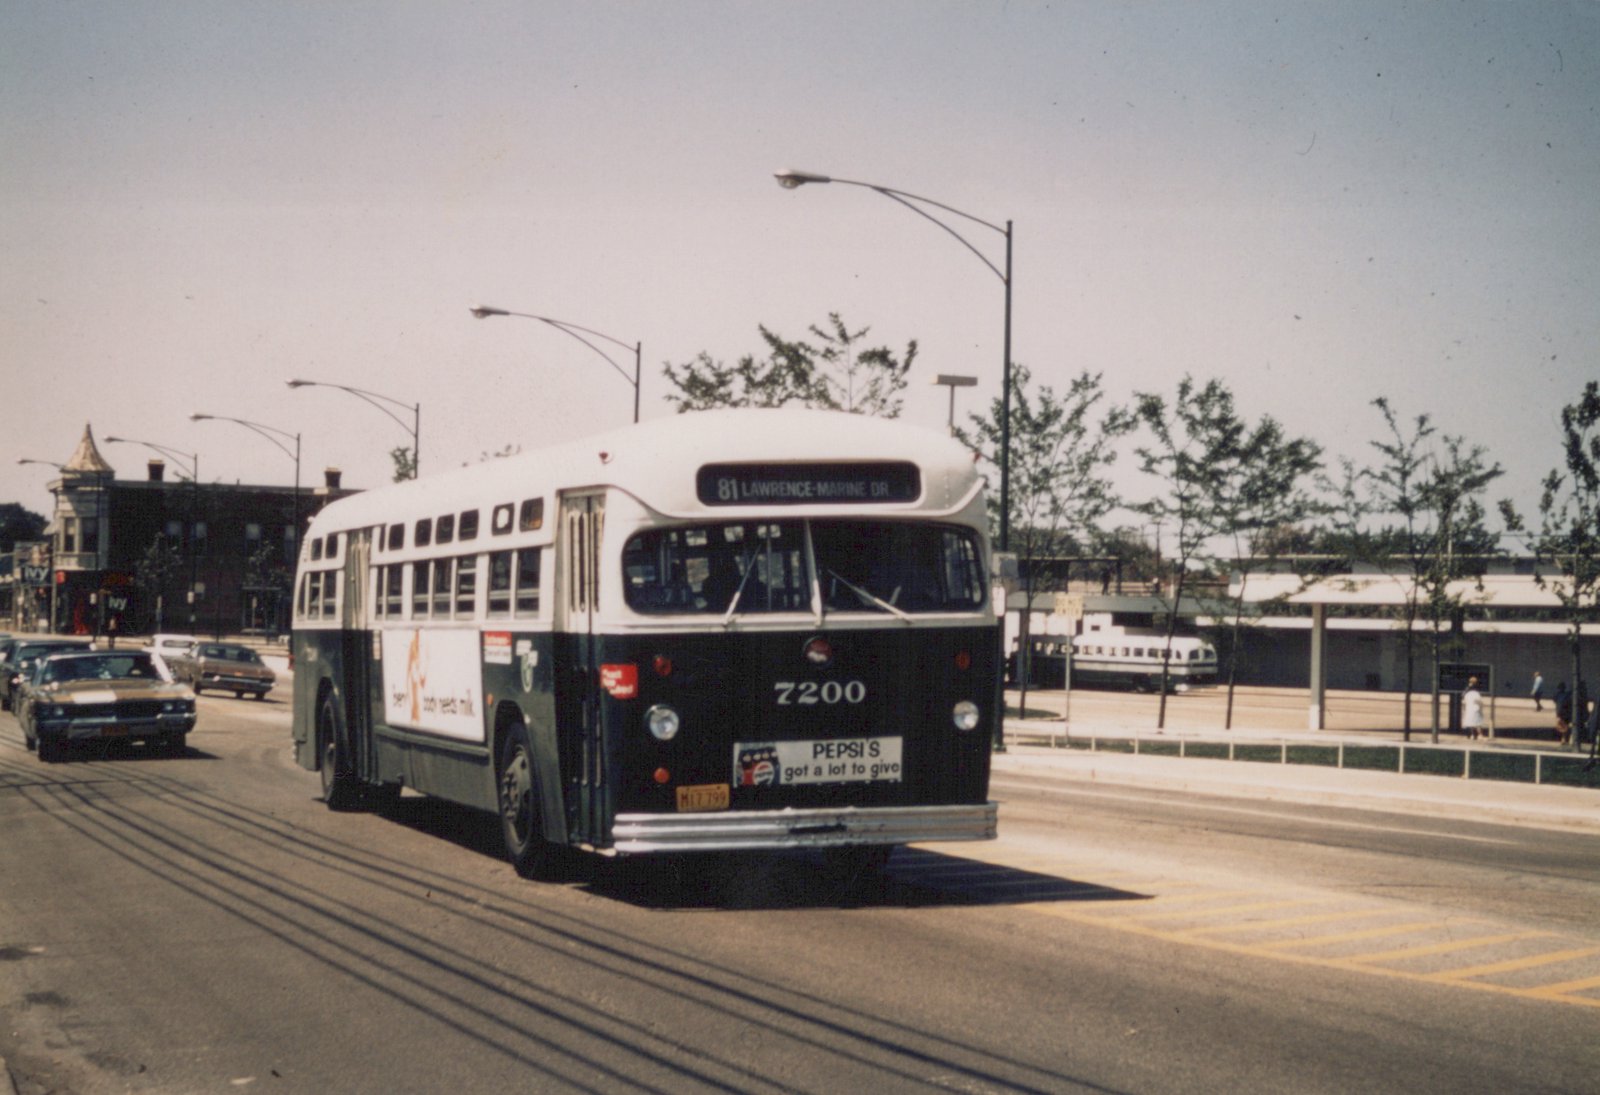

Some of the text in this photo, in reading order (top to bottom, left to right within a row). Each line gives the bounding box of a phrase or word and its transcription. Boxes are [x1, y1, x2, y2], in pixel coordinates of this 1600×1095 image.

[718, 478, 889, 500] 81 LAWRENCE-MARINE DR
[774, 681, 866, 705] 7200
[785, 760, 899, 782] got a lot to give
